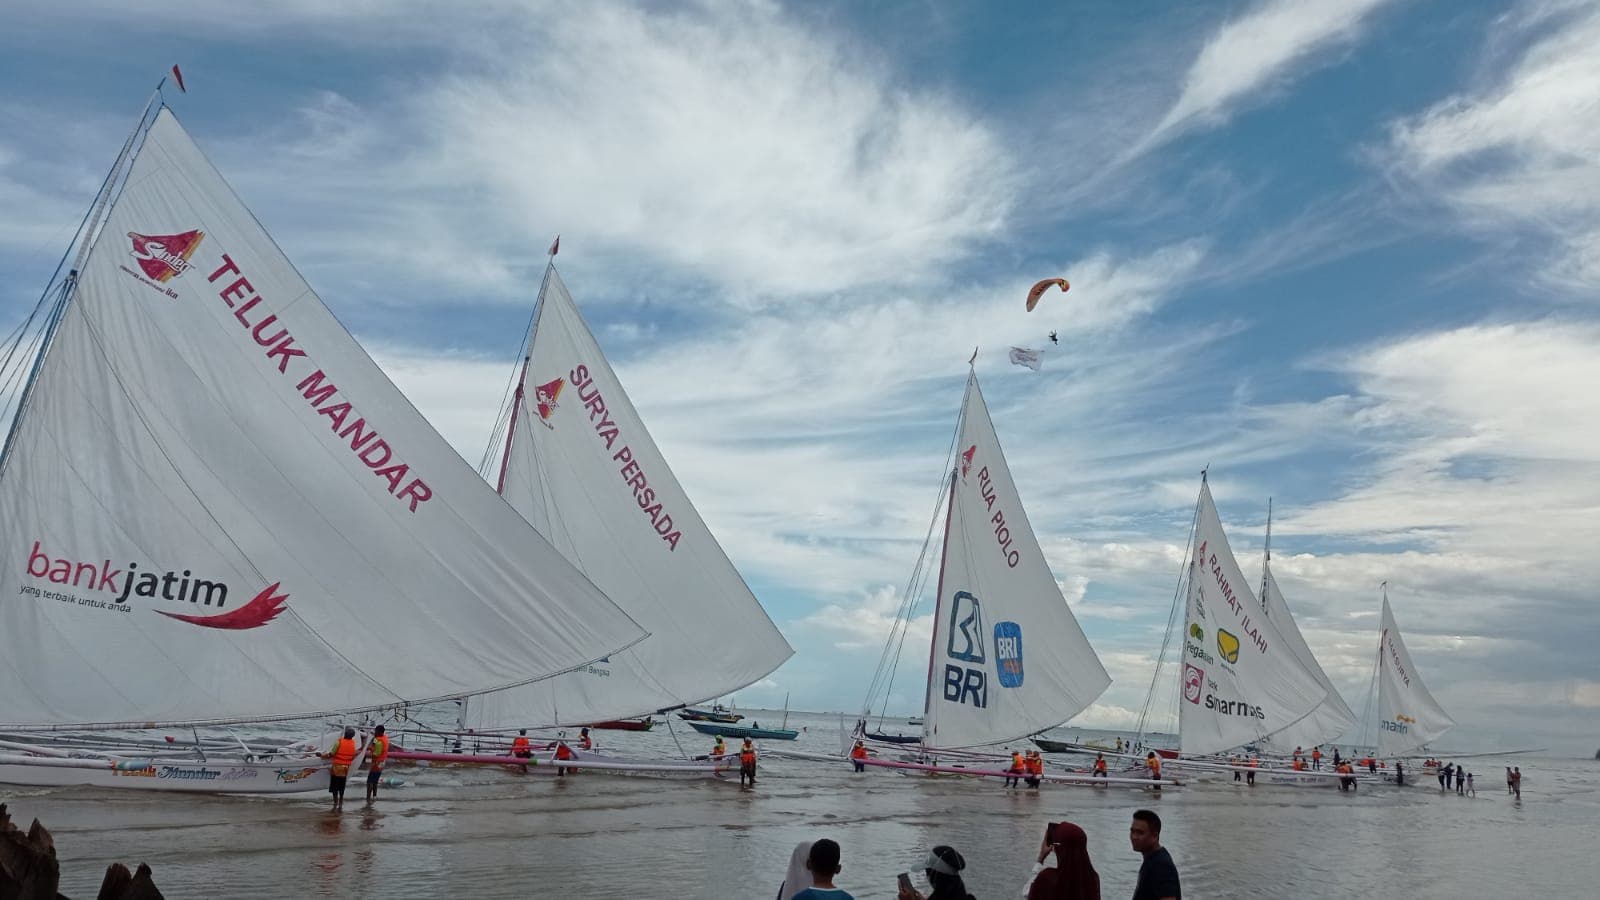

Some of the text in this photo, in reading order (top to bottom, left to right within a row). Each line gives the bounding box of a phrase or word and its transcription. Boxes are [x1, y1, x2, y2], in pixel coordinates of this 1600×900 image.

[207, 253, 433, 513] TELUK MANDAR
[569, 364, 682, 552] SURYA PERSADA
[977, 466, 1020, 569] RUA PIOLO
[19, 584, 132, 613] yang terbaik untuk anda
[998, 636, 1019, 660] BRI
[1208, 553, 1268, 654] RAHMAT ILAHI
[943, 663, 988, 709] BRI
